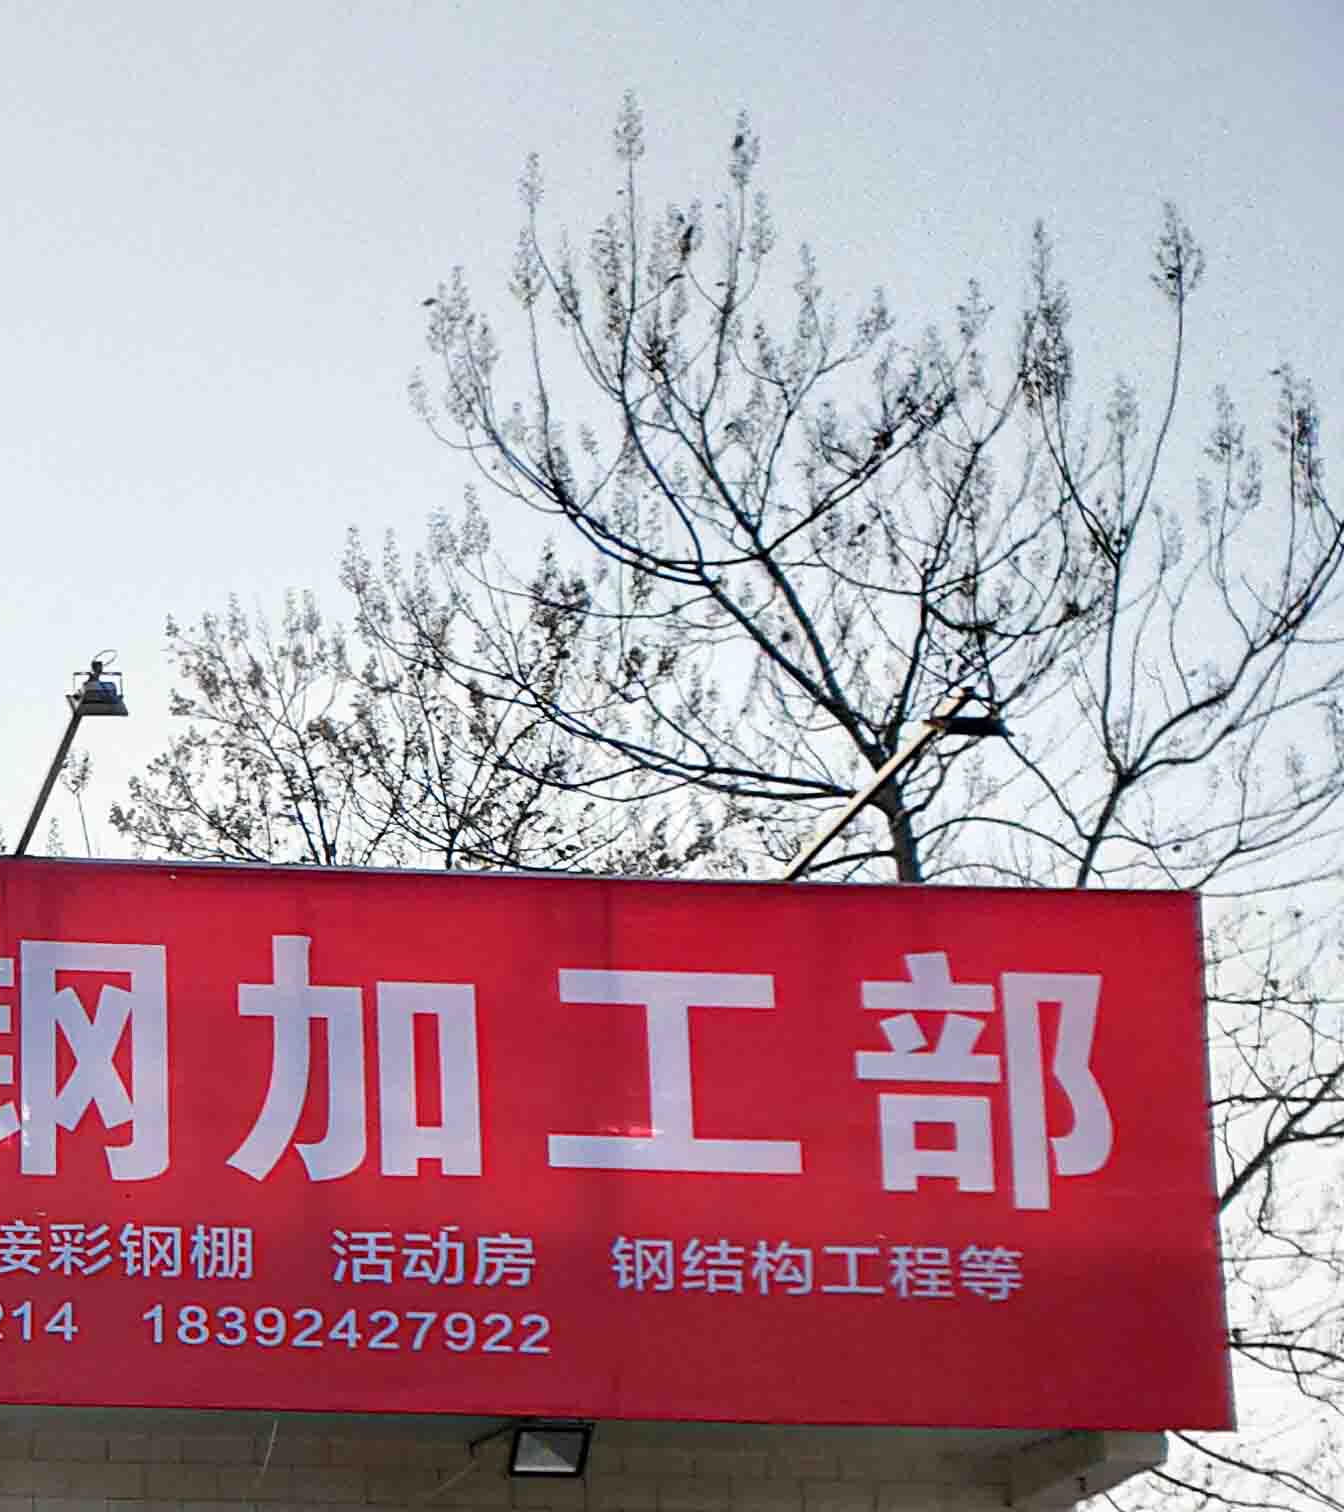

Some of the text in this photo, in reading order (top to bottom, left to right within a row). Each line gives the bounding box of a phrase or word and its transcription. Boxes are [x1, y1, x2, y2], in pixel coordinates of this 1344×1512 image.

[331, 1227, 538, 1289] 活动房
[611, 1234, 1025, 1303] 钢结构工程等
[142, 1304, 553, 1354] 18392427922
